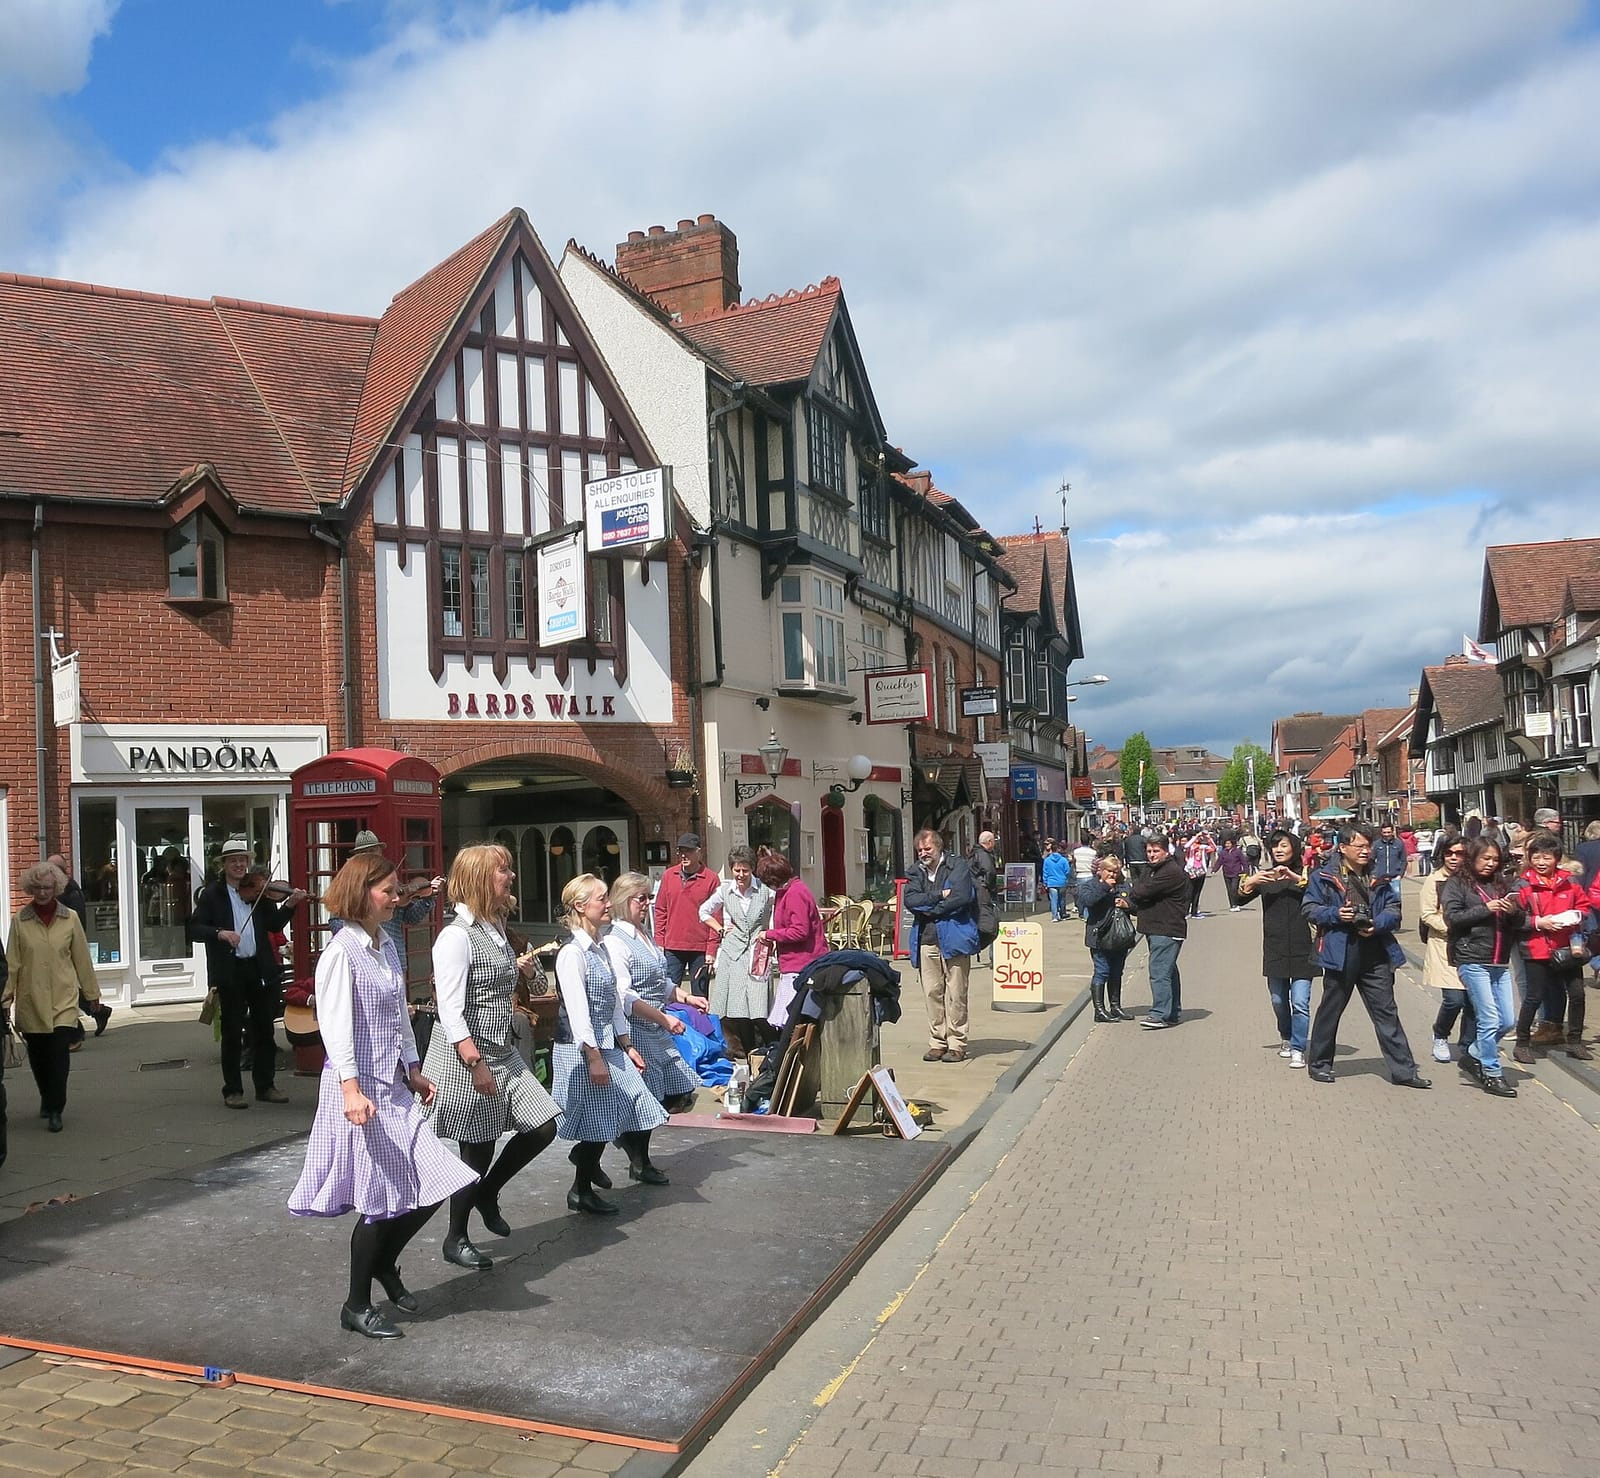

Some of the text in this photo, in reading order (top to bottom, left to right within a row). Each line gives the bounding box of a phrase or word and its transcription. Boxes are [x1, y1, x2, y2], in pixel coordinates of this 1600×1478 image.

[589, 471, 659, 496] SHOPS TO LET
[594, 487, 655, 510] ALL ENQUIRIES
[615, 504, 648, 521] jackson
[628, 513, 648, 524] criss
[549, 558, 572, 573] DISCOVER
[447, 693, 615, 716] BARDS WALK
[129, 742, 279, 769] PANDORA
[308, 780, 373, 794] TELEPHONE
[1001, 941, 1033, 965] Toy
[994, 963, 1043, 991] Shop
